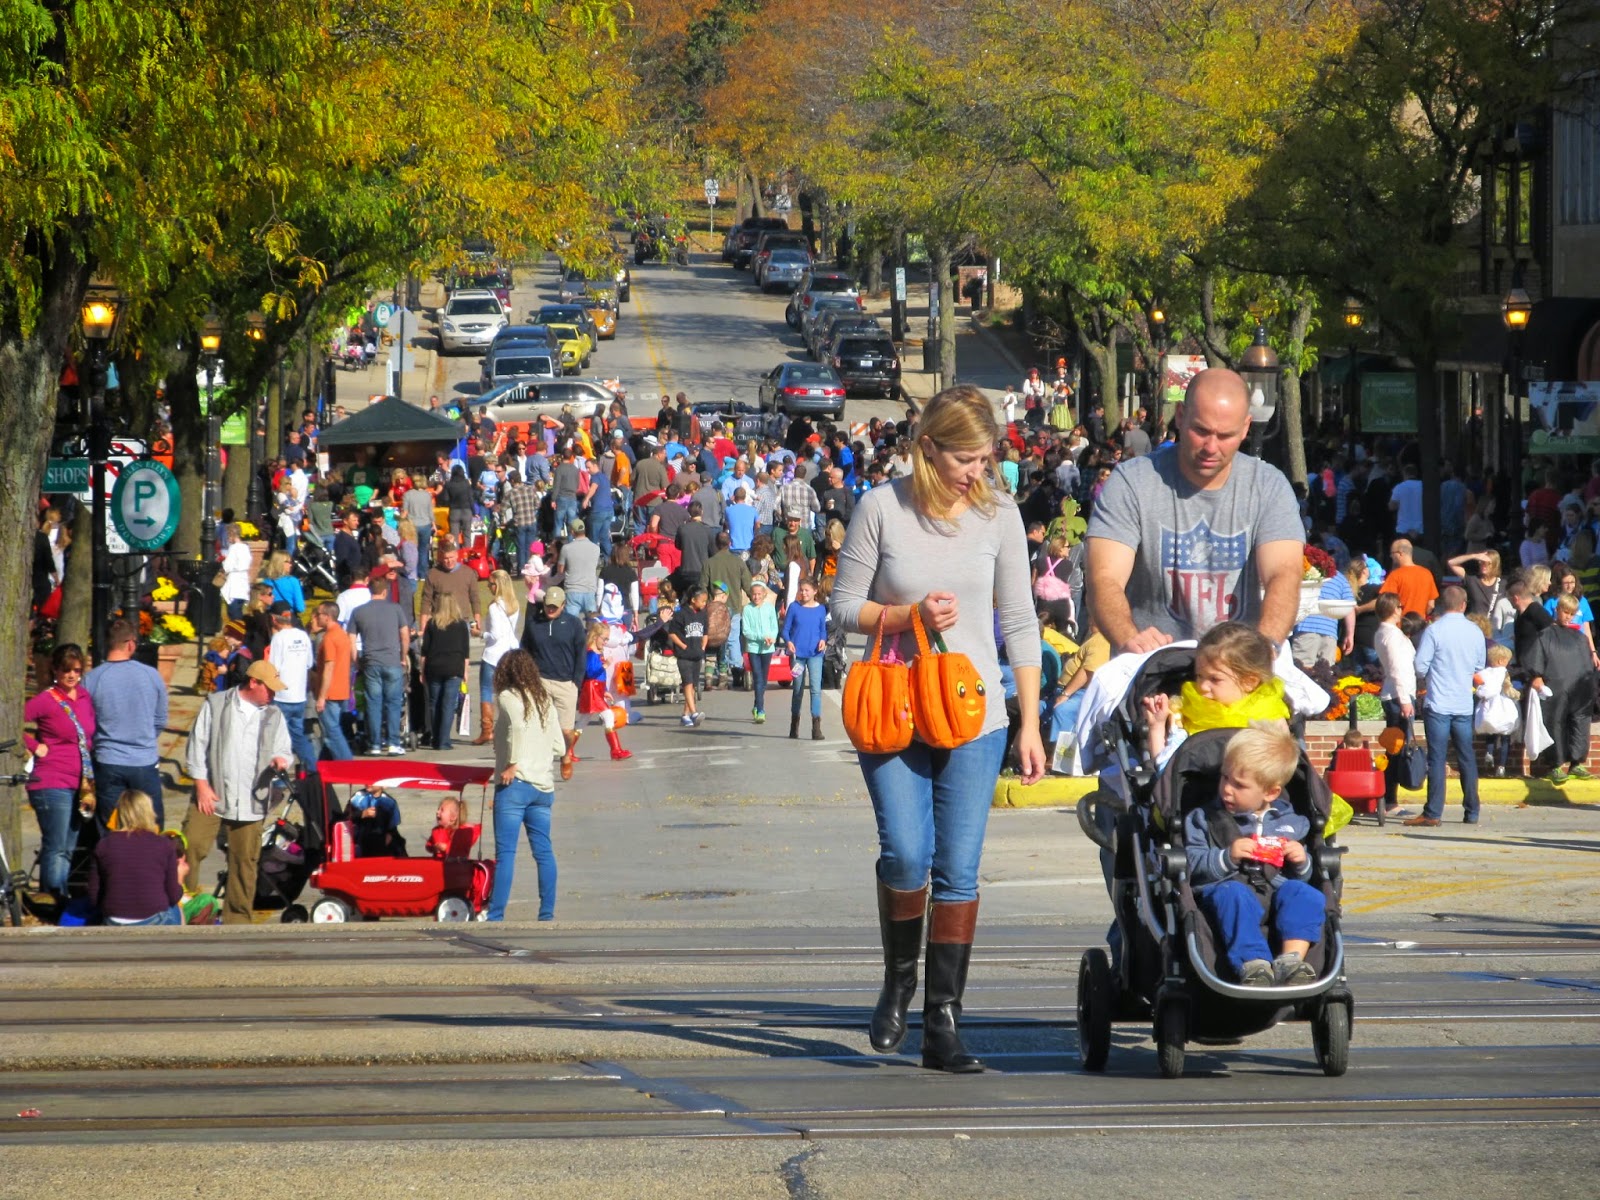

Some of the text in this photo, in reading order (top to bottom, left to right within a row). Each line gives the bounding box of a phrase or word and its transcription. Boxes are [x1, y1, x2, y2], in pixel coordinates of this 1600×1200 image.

[47, 467, 88, 484] SHOPS
[122, 460, 170, 480] GLEN ELLYN
[134, 480, 157, 512] P
[117, 523, 172, 549] DOWNTOWN
[1167, 570, 1238, 631] NFL
